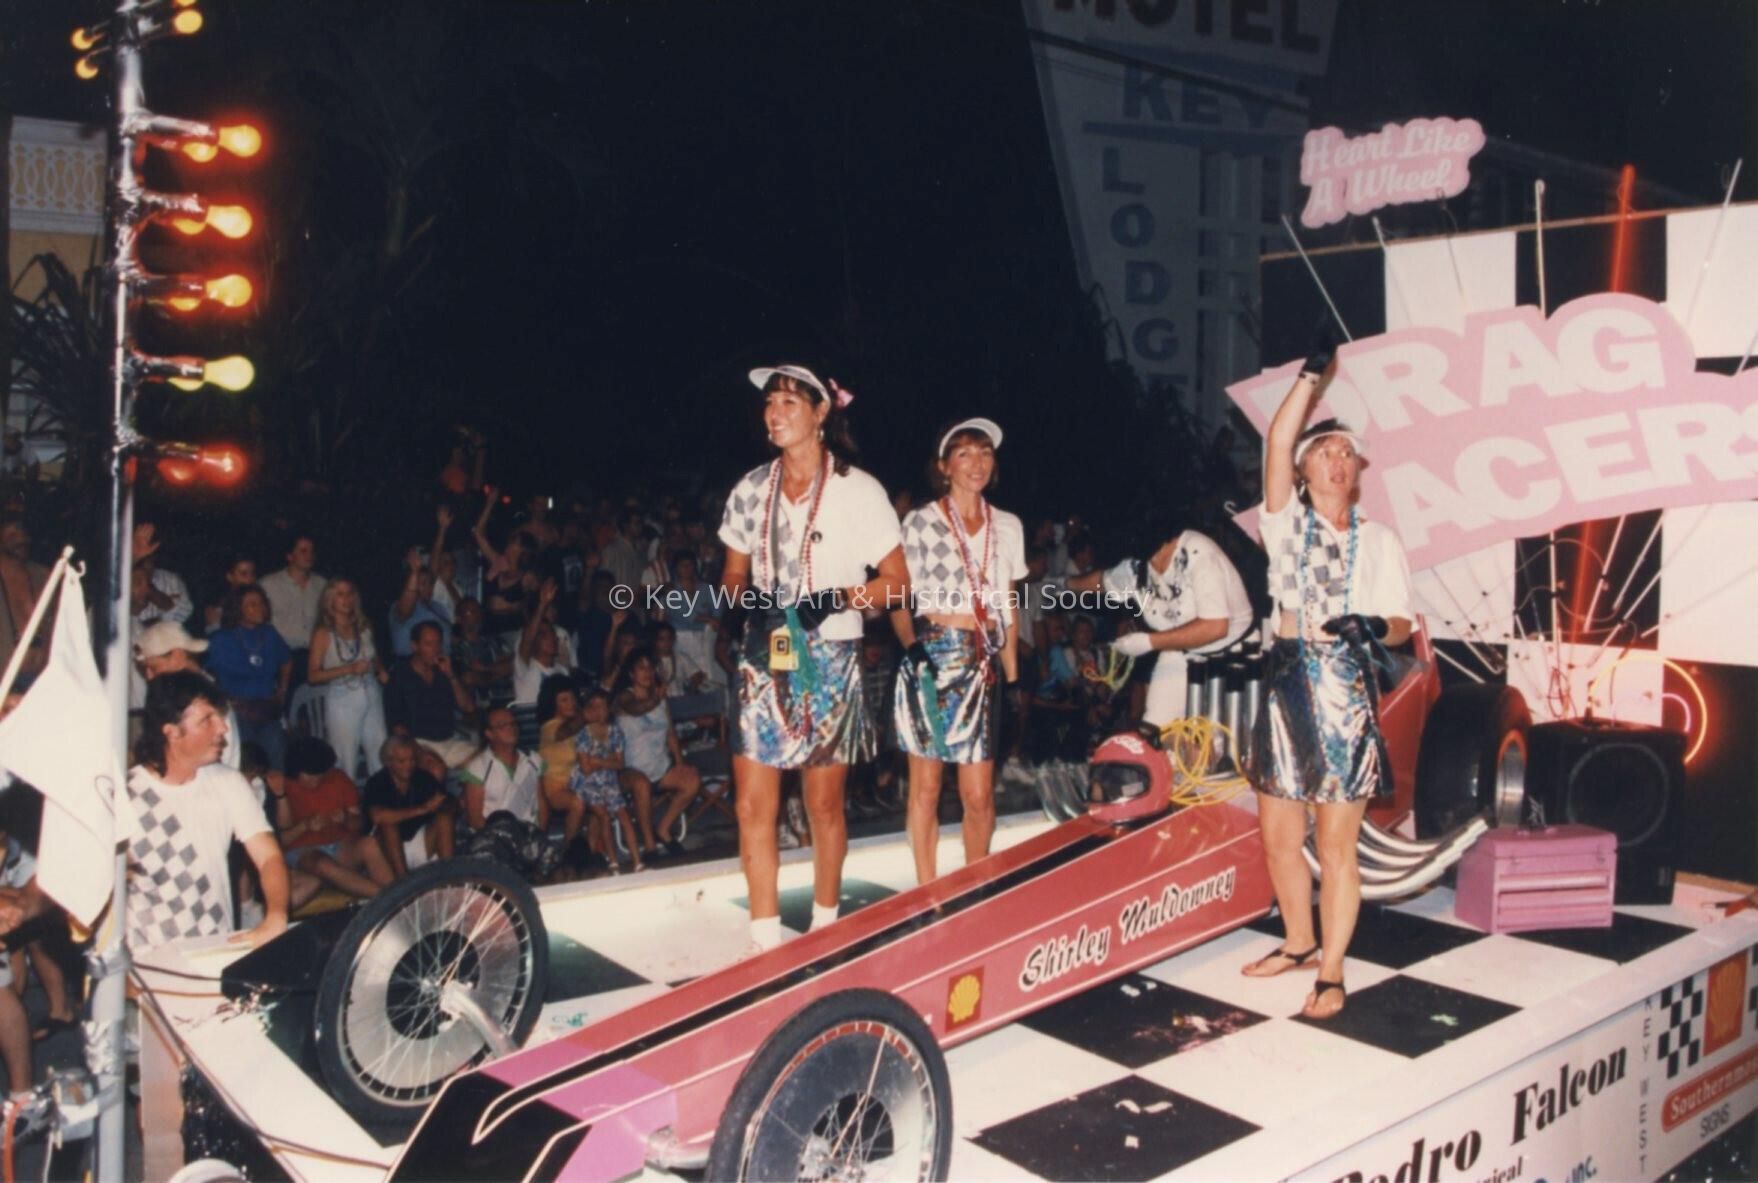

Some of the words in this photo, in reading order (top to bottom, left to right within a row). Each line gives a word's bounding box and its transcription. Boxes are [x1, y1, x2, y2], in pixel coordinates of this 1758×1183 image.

[1123, 65, 1273, 129] KEY
[1303, 128, 1393, 177] Heart
[1397, 124, 1470, 158] Like
[1309, 177, 1335, 214] A
[1350, 160, 1451, 204] Wheel
[1102, 146, 1188, 384] LODG
[1019, 925, 1111, 992] Shirley
[1119, 865, 1236, 944] Muldowney
[1510, 1044, 1627, 1146] Falcon
